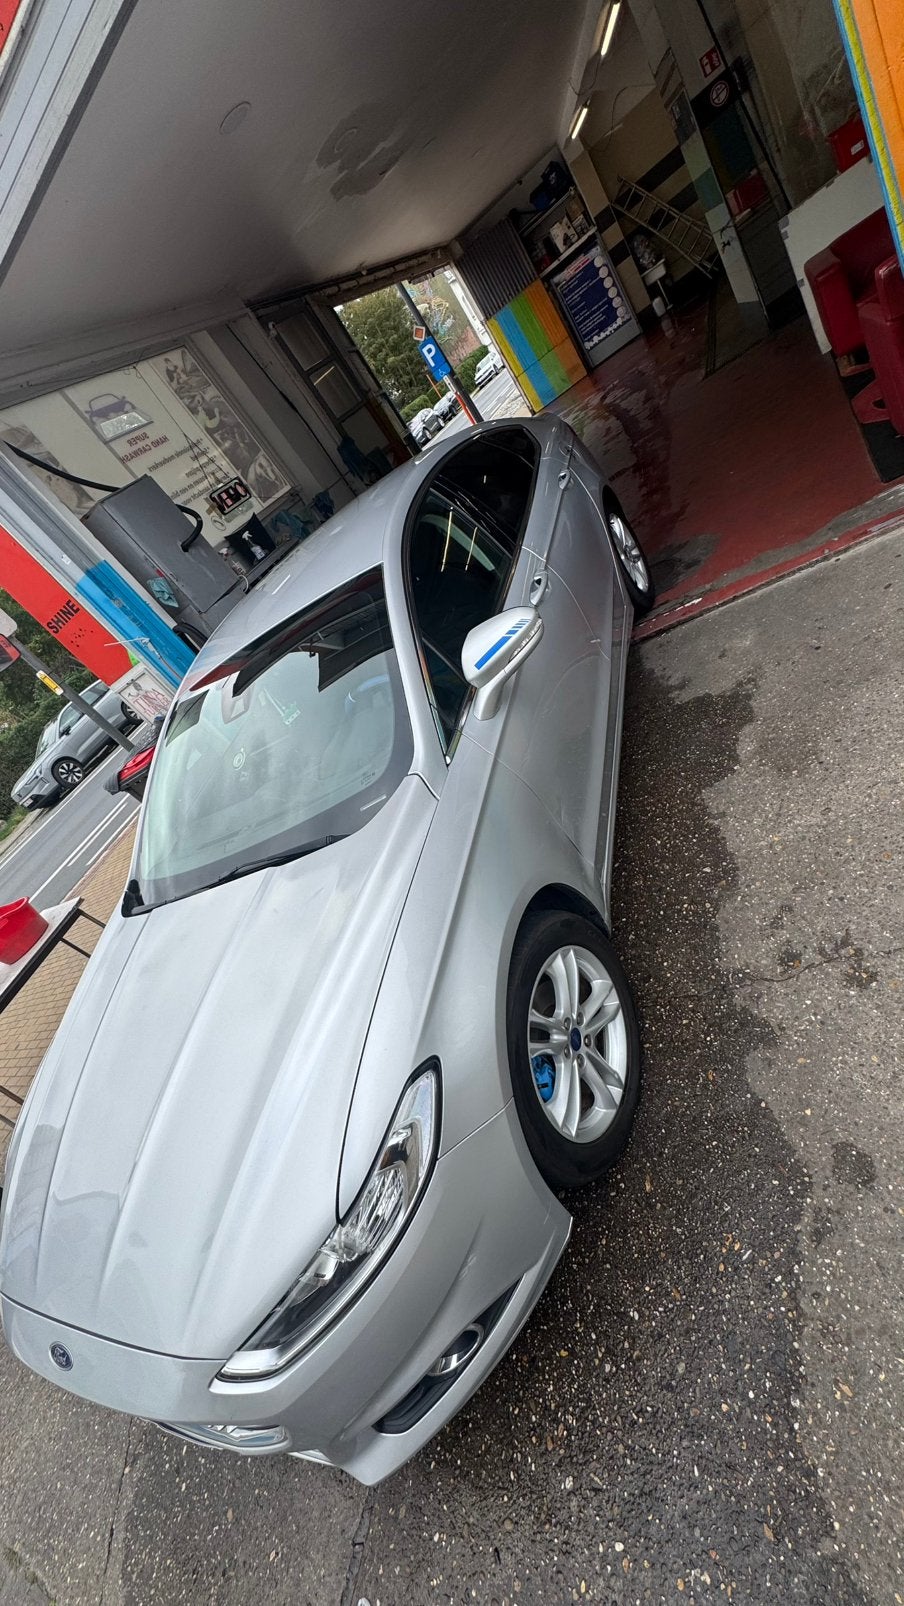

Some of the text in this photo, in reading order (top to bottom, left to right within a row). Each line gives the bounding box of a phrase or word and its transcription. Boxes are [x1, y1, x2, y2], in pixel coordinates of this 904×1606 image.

[422, 343, 436, 367] P
[47, 599, 80, 634] SHINE
[133, 688, 165, 710] TINA
